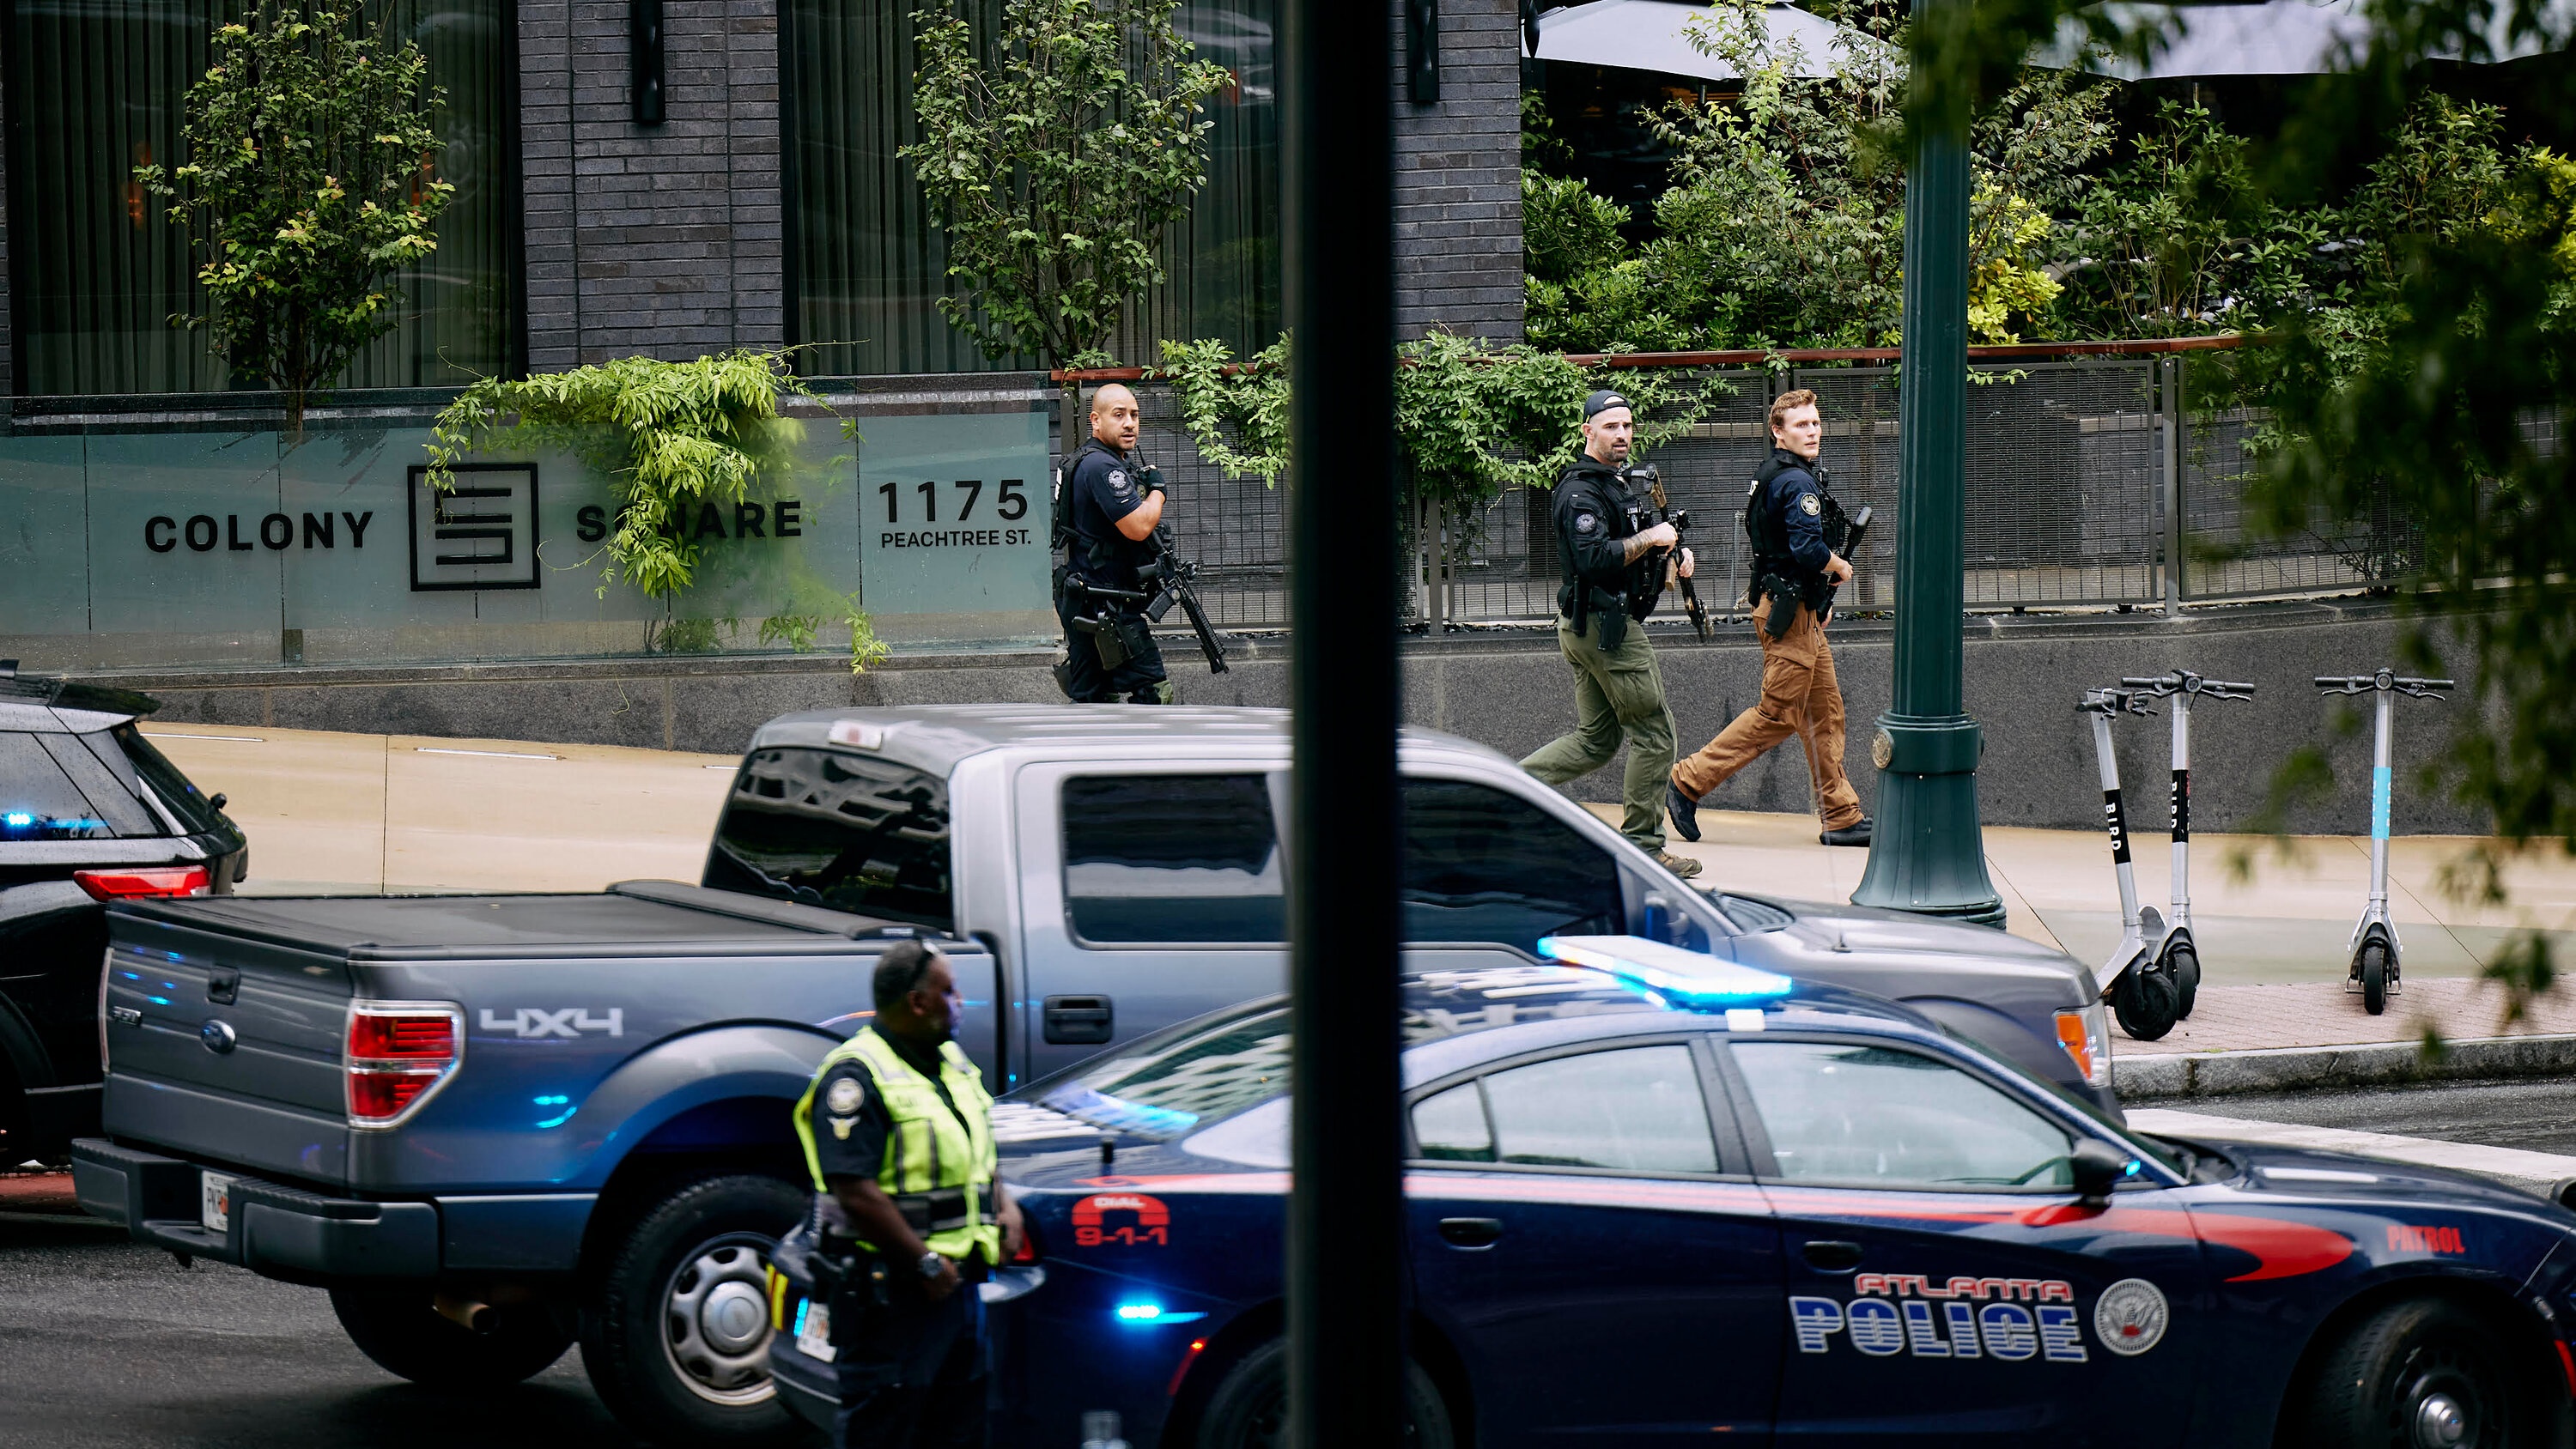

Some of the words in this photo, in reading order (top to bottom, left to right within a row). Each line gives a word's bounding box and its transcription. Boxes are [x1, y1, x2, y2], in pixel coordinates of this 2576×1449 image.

[879, 479, 1029, 523] 1175
[144, 511, 374, 553] COLONY
[881, 529, 999, 549] PEACHTREE
[1005, 529, 1032, 545] ST.
[2105, 802, 2122, 851] BIRD
[479, 1007, 623, 1039] 4X4
[1093, 1197, 1145, 1209] DIAL
[1074, 1226, 1169, 1246] 9-1-1
[2386, 1225, 2465, 1254] PATROL
[1855, 1272, 2074, 1302] ATLANTA
[1789, 1295, 2089, 1363] POLICE
